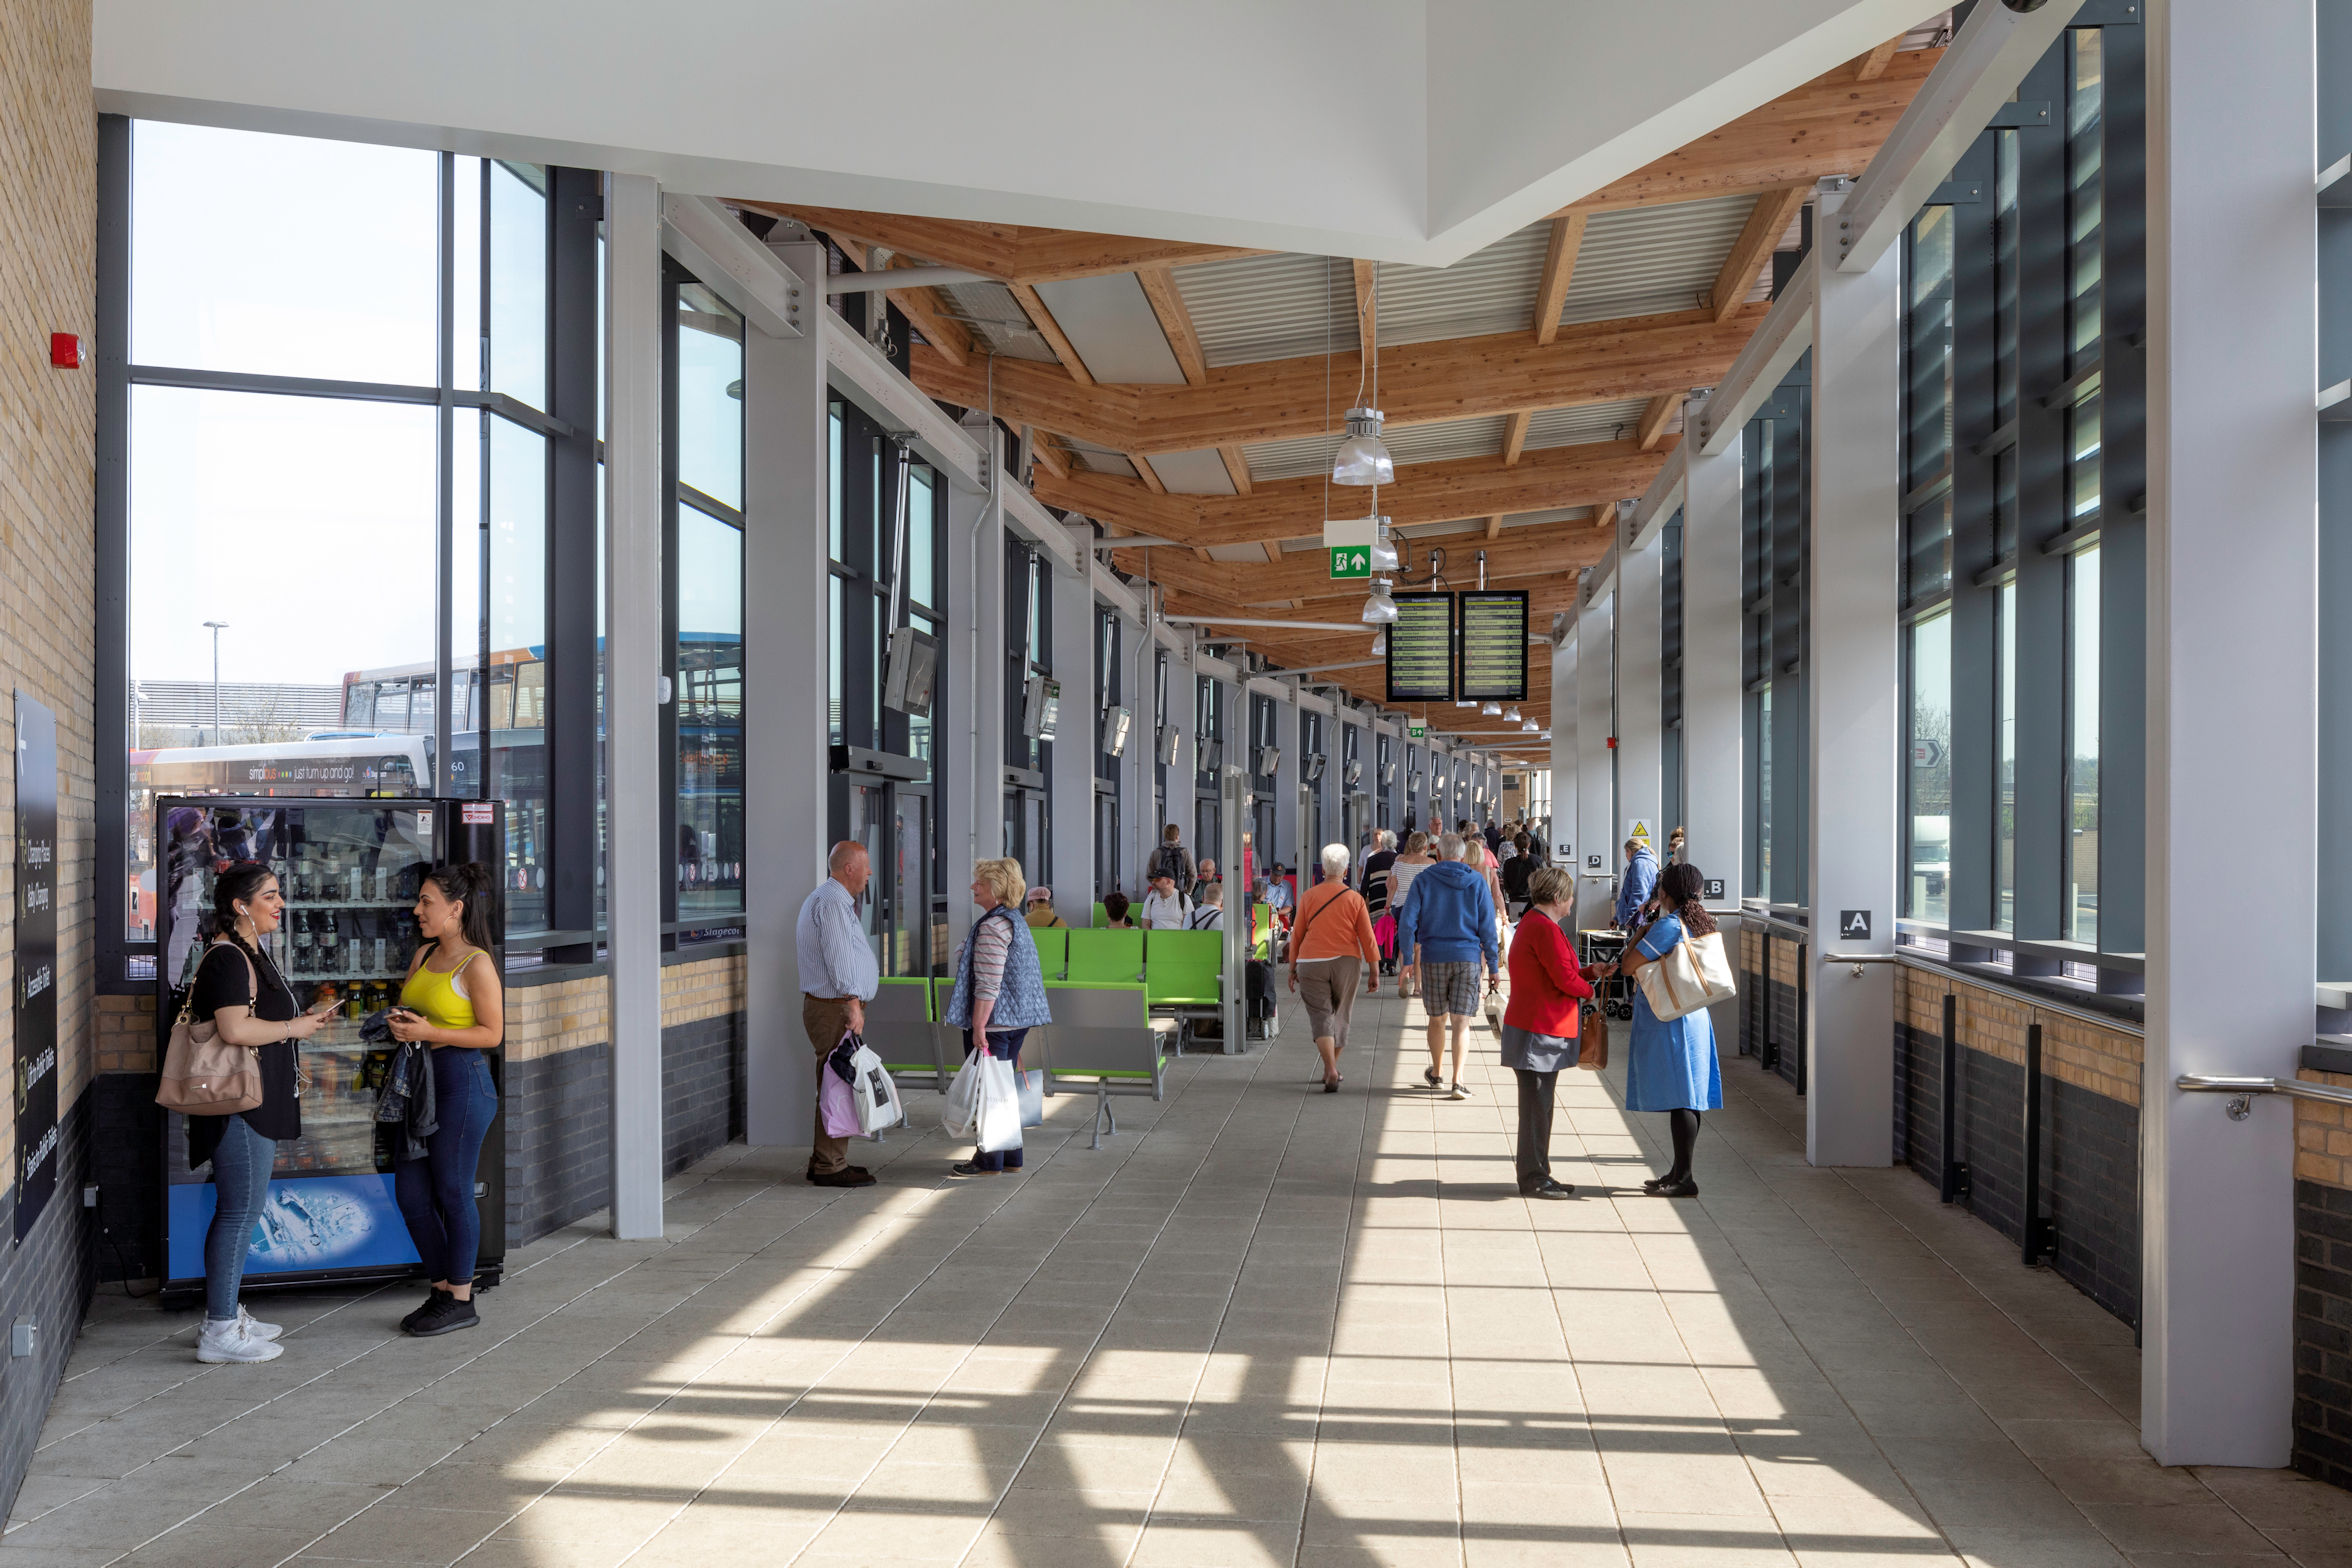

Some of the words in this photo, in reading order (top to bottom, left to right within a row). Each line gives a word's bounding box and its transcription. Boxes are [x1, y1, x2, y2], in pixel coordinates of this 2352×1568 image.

[320, 767, 328, 781] up
[329, 764, 343, 779] and
[28, 839, 41, 870] Changing
[1563, 845, 1569, 853] E
[1592, 856, 1600, 865] D
[36, 881, 49, 910] Changing
[1711, 880, 1722, 894] B
[1847, 912, 1868, 931] A
